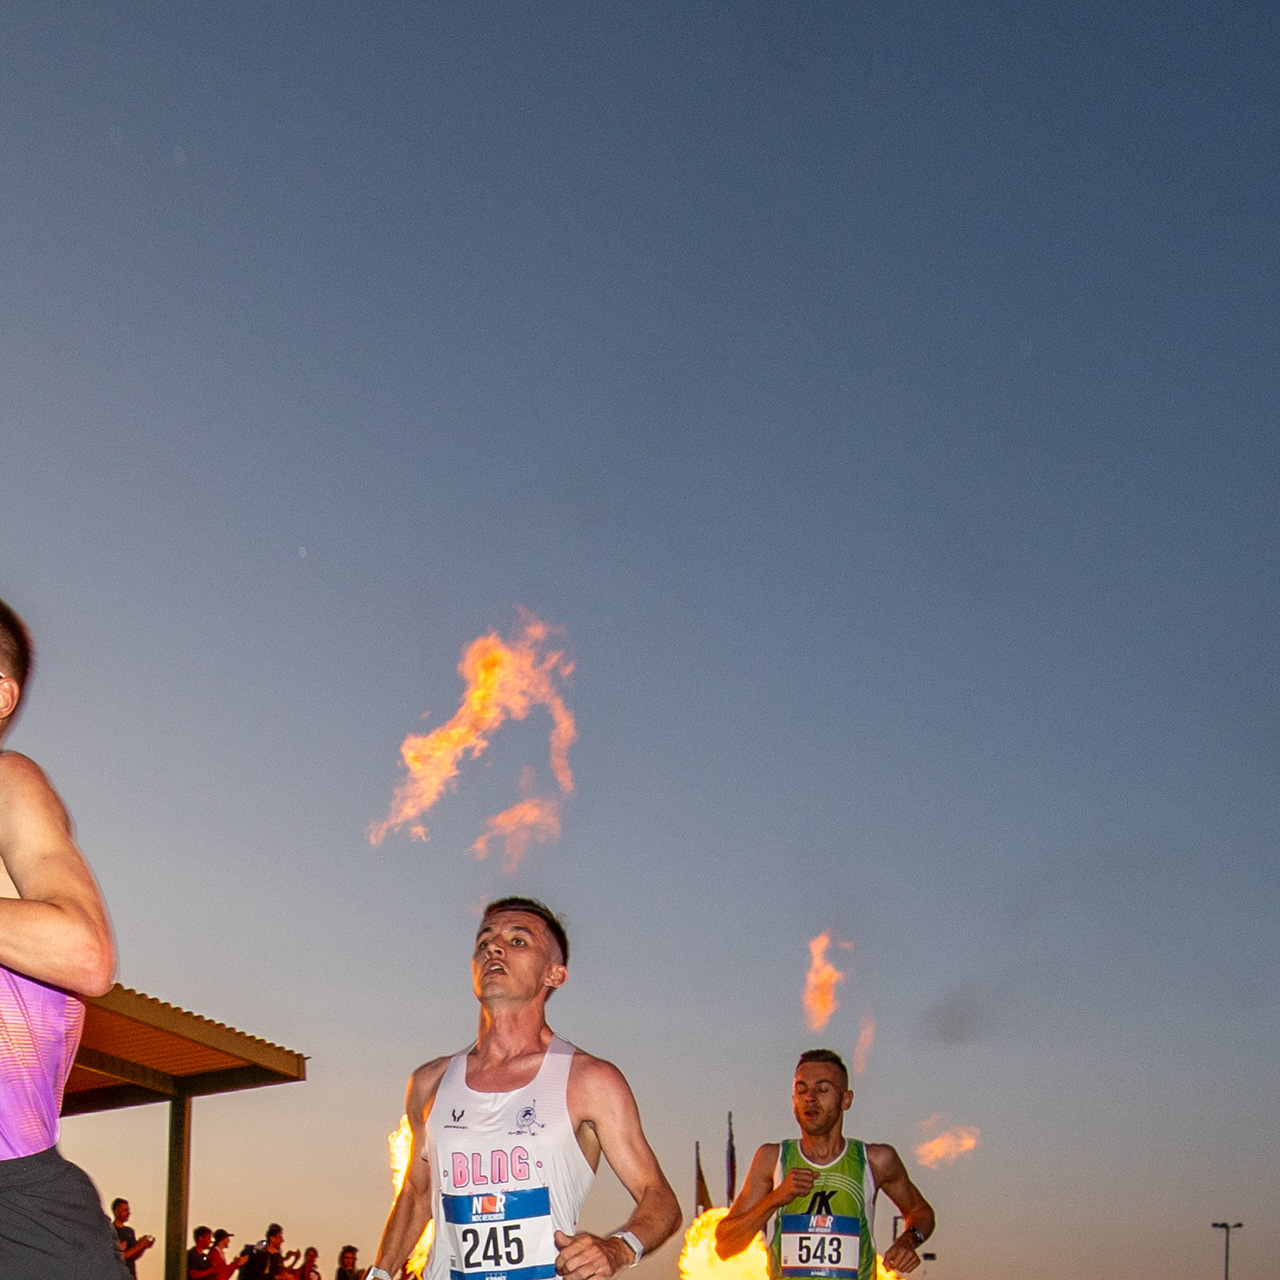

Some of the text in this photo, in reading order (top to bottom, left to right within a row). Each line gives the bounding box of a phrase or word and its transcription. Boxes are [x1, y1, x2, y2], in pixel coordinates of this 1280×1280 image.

[451, 1145, 530, 1189] BLNG
[462, 1224, 524, 1268] 245
[798, 1236, 842, 1264] 543
